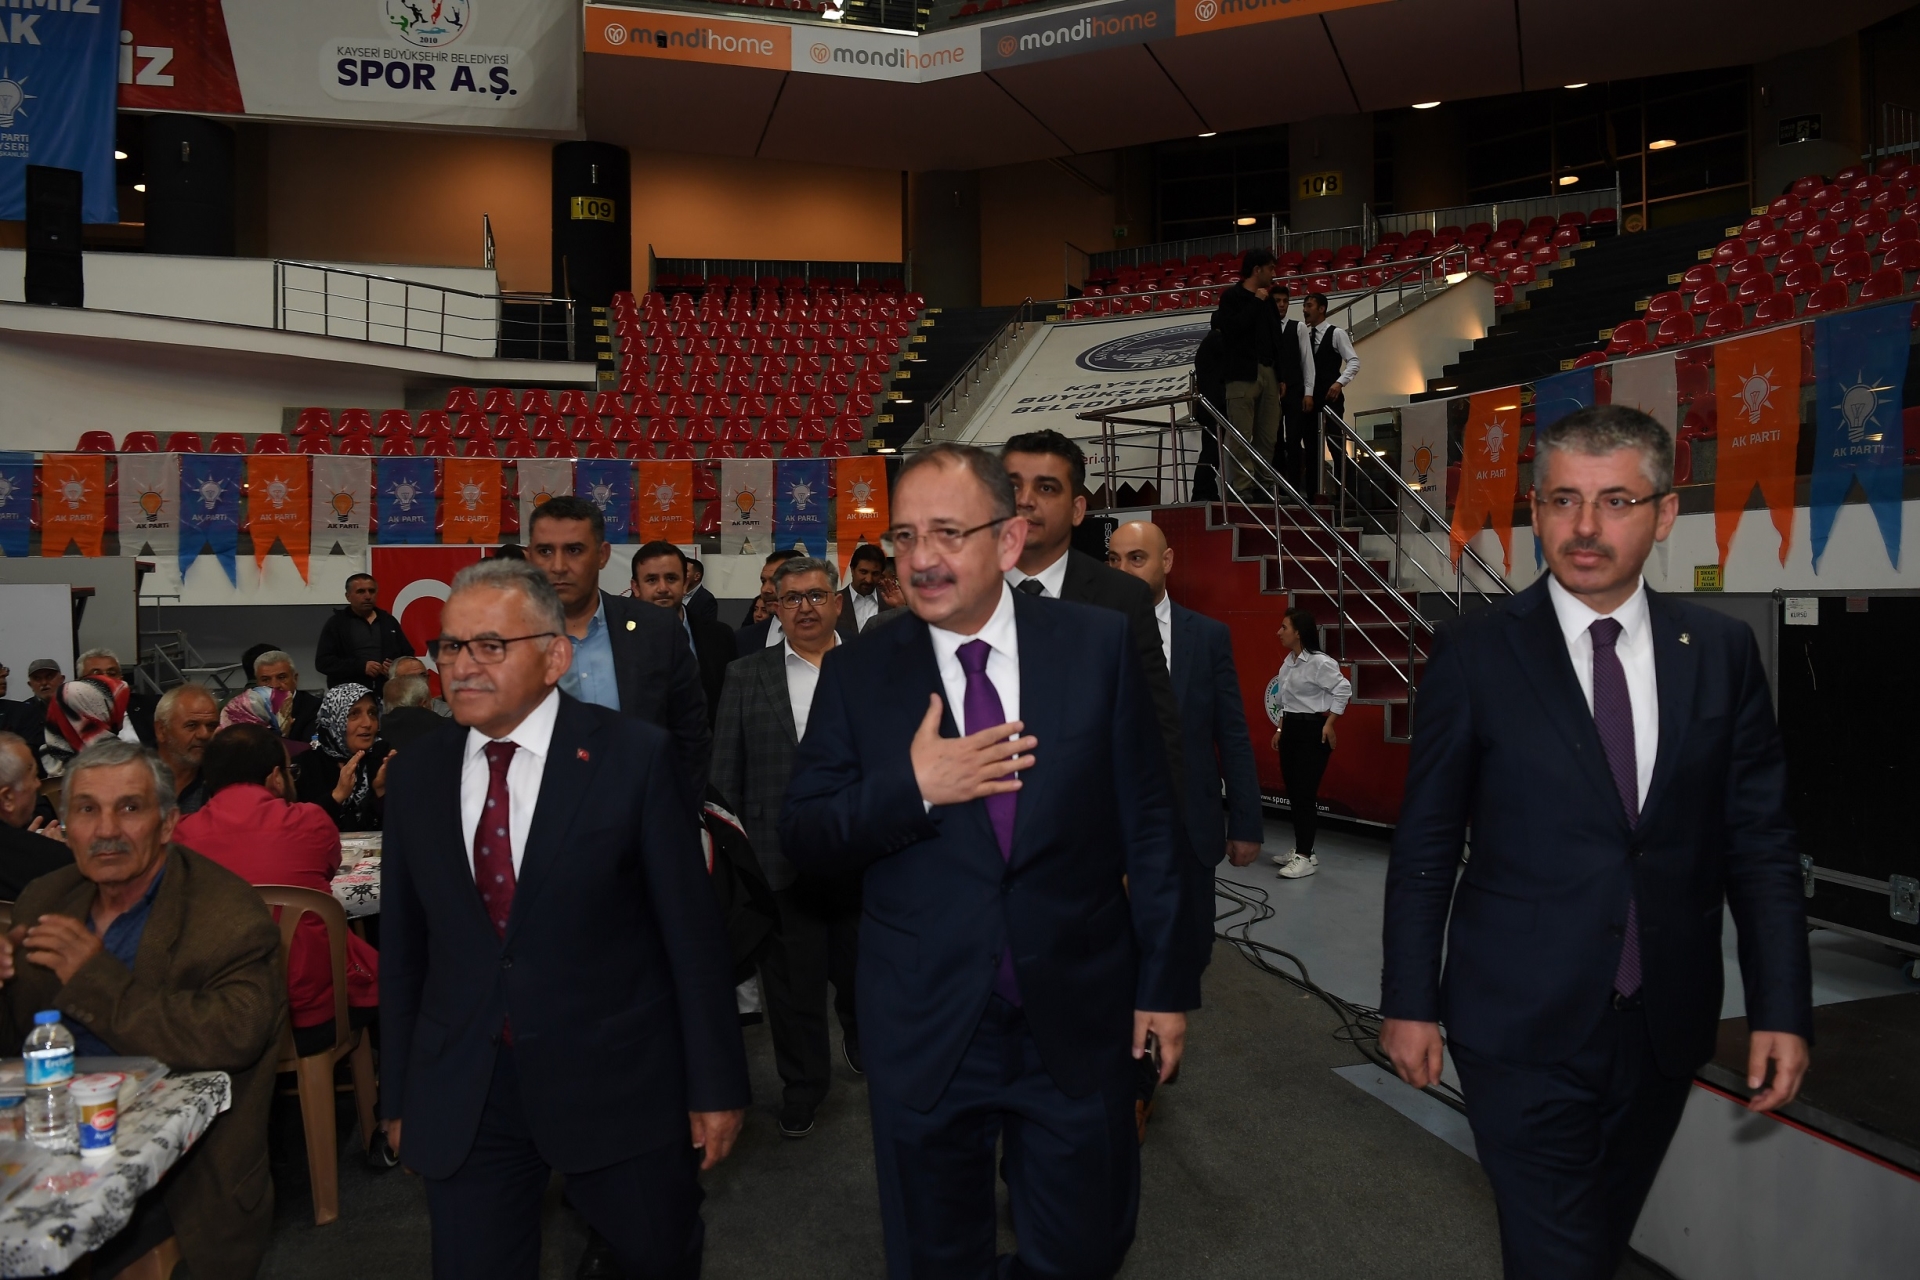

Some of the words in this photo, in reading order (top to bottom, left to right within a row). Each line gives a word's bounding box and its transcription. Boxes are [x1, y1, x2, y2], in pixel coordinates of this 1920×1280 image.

[419, 36, 438, 44] 2010
[1019, 11, 1157, 51] mondihome
[337, 46, 381, 58] KAYSERİ
[383, 49, 448, 63] BÜYÜKŞEHİR
[451, 53, 509, 65] BELEDİYESİ
[833, 47, 965, 70] mondihome
[337, 58, 436, 91] SPOR
[450, 65, 517, 101] A.Ş.
[1302, 175, 1338, 195] 108
[576, 200, 611, 218] 109
[1018, 383, 1190, 404] BÜYÜKŞEHİ
[1731, 435, 1747, 449] AK
[1832, 447, 1847, 458] AK
[1476, 470, 1489, 480] AK
[54, 514, 67, 522] AK
